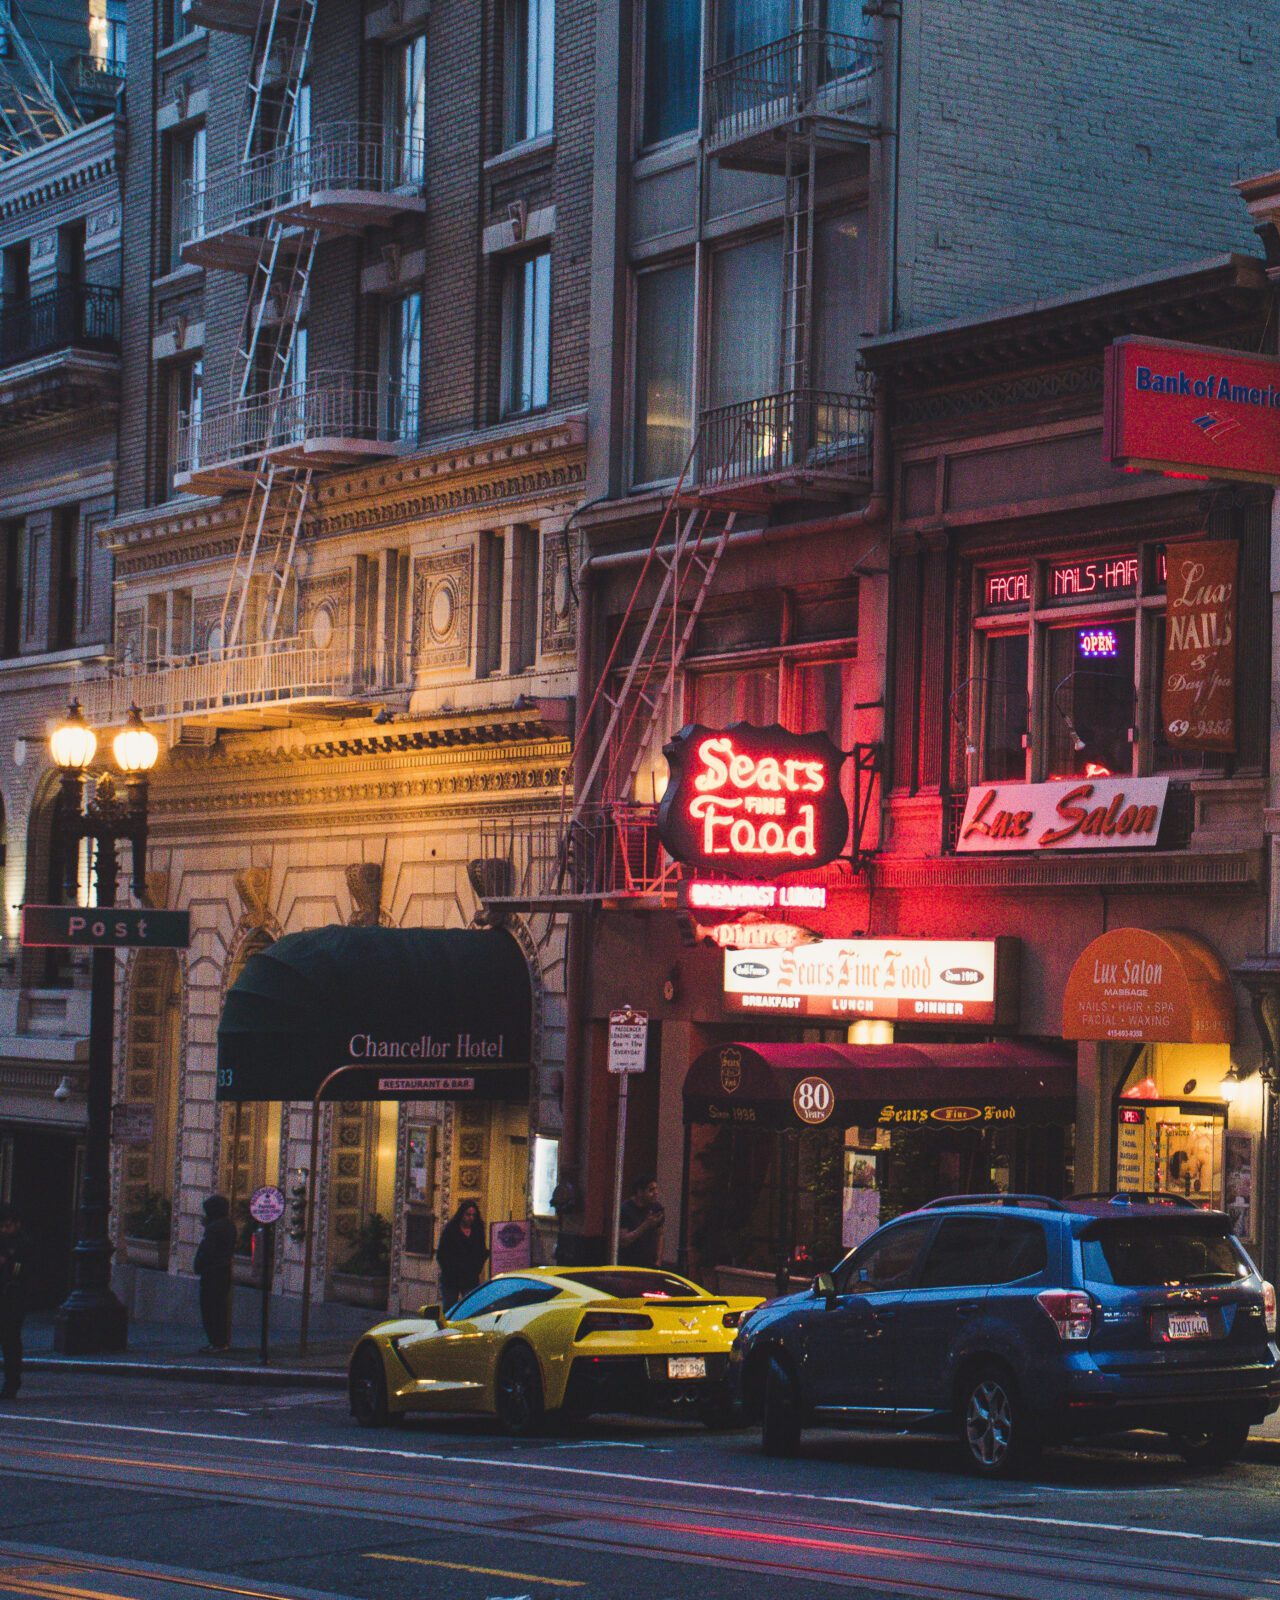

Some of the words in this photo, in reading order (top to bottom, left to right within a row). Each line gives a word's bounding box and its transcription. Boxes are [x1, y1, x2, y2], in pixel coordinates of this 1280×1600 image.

[1136, 365, 1191, 396] Bank
[1193, 374, 1216, 399] of
[989, 573, 1031, 604] FACIAL
[1173, 561, 1233, 609] Lux
[1168, 612, 1233, 651] NAILS
[1083, 635, 1114, 652] OPEN
[1167, 672, 1205, 702] Day
[694, 738, 826, 792] Sears
[744, 796, 786, 816] FINE
[963, 789, 1034, 840] Lux
[1038, 784, 1159, 845] Salon
[689, 794, 818, 856] Food
[67, 916, 149, 939] Post
[718, 923, 799, 945] Dinner
[776, 949, 834, 989] Sears
[836, 949, 881, 990] Fine
[883, 949, 932, 990] Food
[1093, 959, 1119, 984] Lux
[1123, 959, 1163, 985] Salon
[741, 994, 801, 1009] BREAKFAST
[1103, 988, 1150, 997] MASSAGE
[831, 999, 875, 1012] LUNCH
[914, 1000, 964, 1015] DINNER
[1078, 1001, 1108, 1012] NAILS
[1118, 1001, 1143, 1013] HAIR
[1154, 1001, 1175, 1013] SPA
[1082, 1015, 1117, 1026] FACIAL
[1128, 1015, 1170, 1026] WAXING
[349, 1033, 451, 1058] Chancellor
[456, 1033, 504, 1059] Hotel
[383, 1079, 441, 1090] RESTAURANT
[450, 1080, 470, 1090] BAR
[798, 1083, 830, 1110] 80
[804, 1109, 825, 1119] Years
[877, 1105, 928, 1123] Sears
[945, 1109, 968, 1119] Fine
[984, 1106, 1016, 1120] Food
